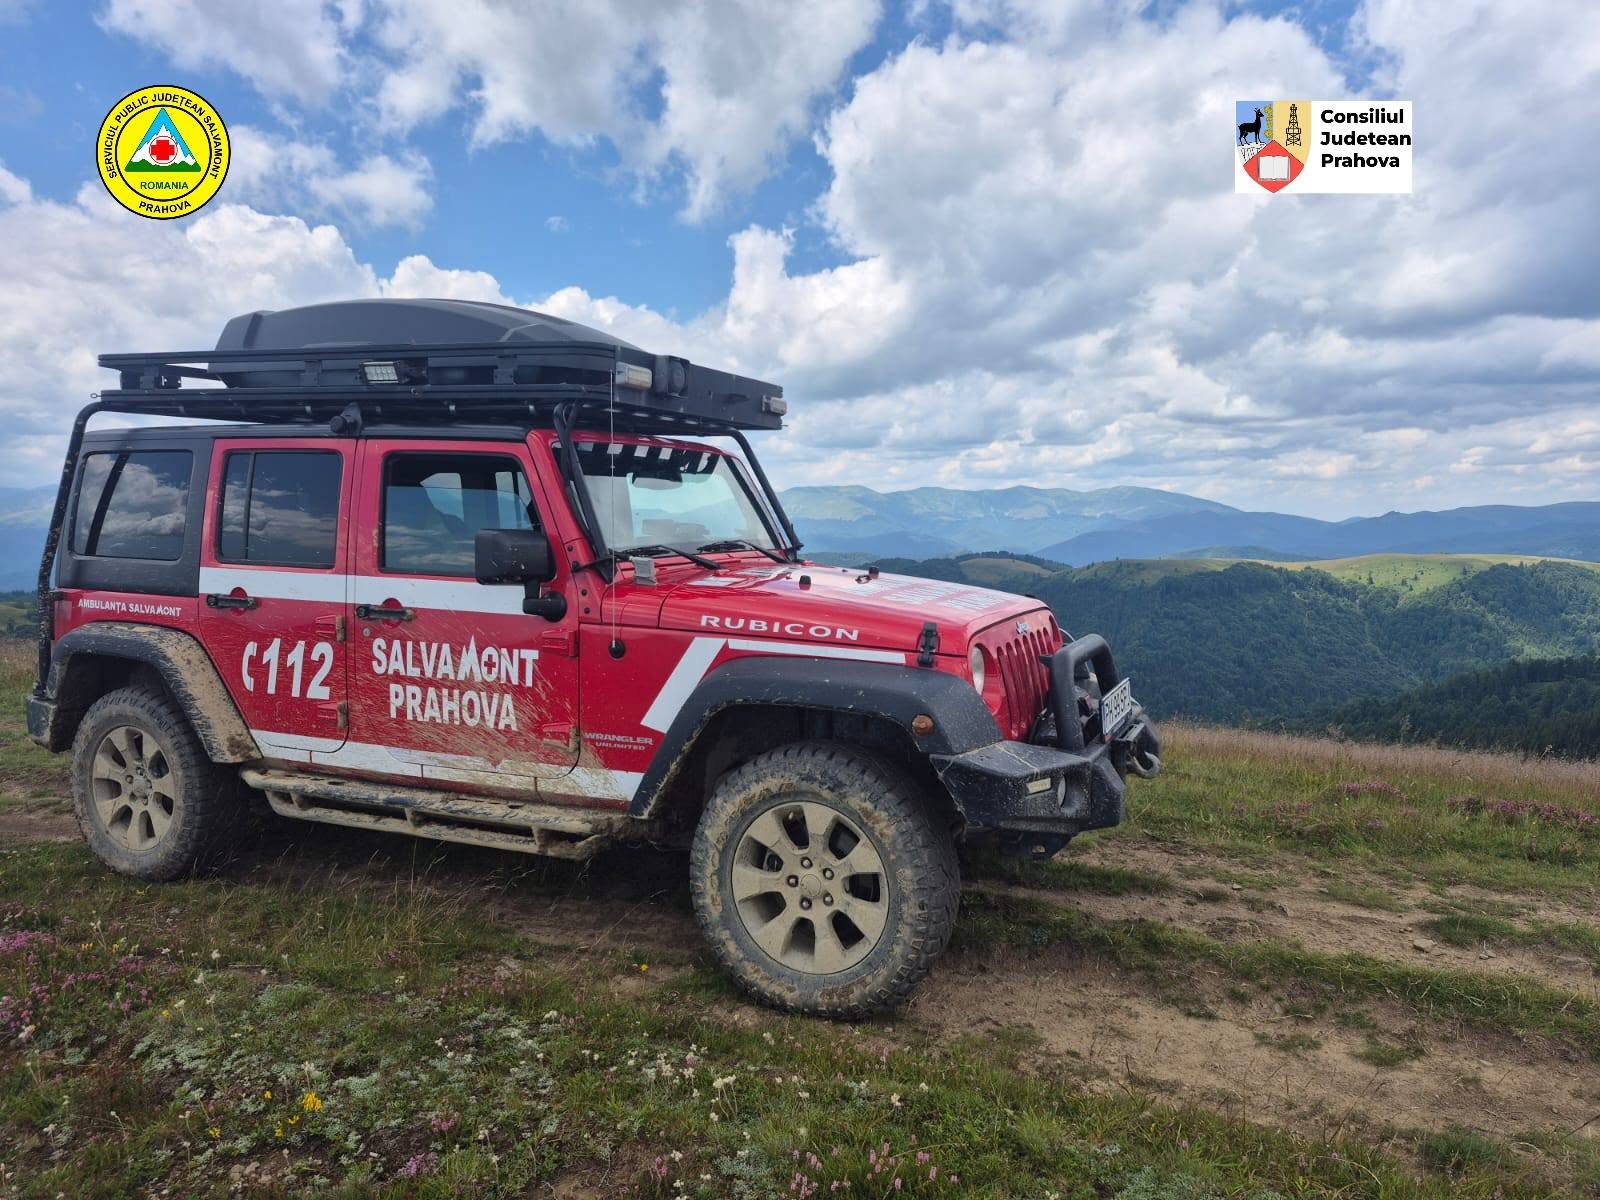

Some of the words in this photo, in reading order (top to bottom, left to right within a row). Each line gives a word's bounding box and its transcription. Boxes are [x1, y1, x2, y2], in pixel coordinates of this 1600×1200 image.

[128, 603, 182, 617] SALVAMONT
[700, 615, 860, 641] RUBICON
[262, 637, 335, 700] 112
[371, 634, 539, 688] SALVAMONT
[389, 683, 518, 732] PRAHOVA
[583, 732, 654, 746] WRANGLER
[595, 741, 646, 751] UNLIMITED
